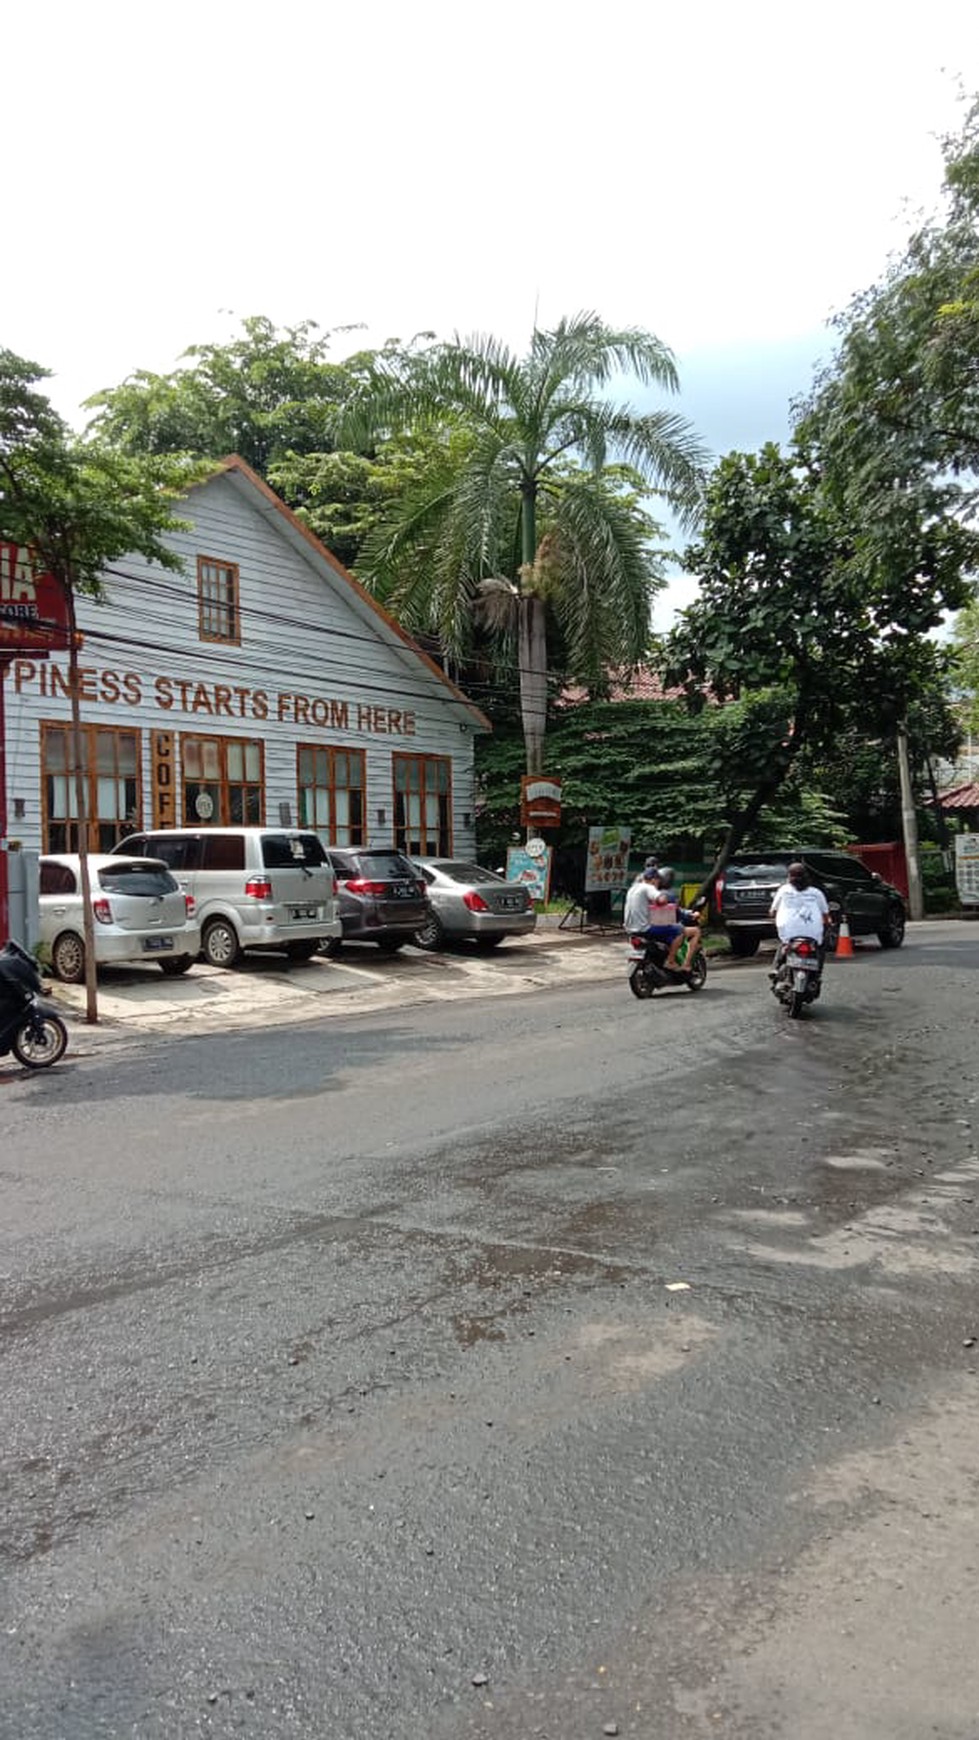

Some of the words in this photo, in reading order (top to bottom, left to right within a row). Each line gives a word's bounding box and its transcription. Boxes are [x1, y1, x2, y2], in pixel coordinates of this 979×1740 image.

[3, 660, 142, 705] PINESS
[154, 676, 269, 720] STARTS
[277, 691, 349, 730] FROM
[356, 703, 416, 736] HERE
